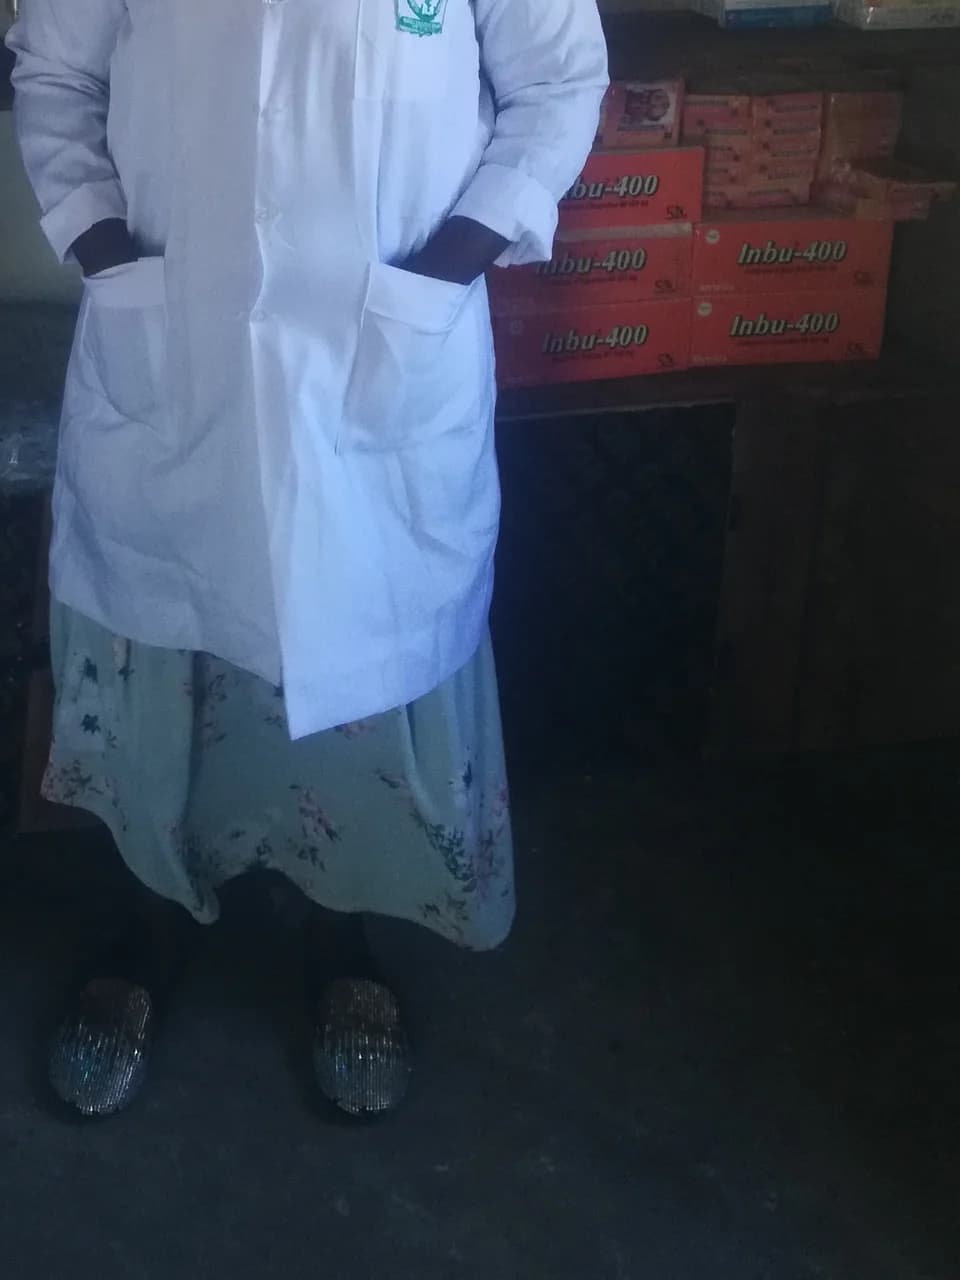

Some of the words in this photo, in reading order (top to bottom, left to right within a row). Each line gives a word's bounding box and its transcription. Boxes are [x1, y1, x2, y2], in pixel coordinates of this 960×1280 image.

[563, 174, 659, 201] bu-400
[736, 239, 847, 266] Inbu-400
[729, 312, 839, 338] Inbu-400
[542, 324, 648, 354] Inbu-400
